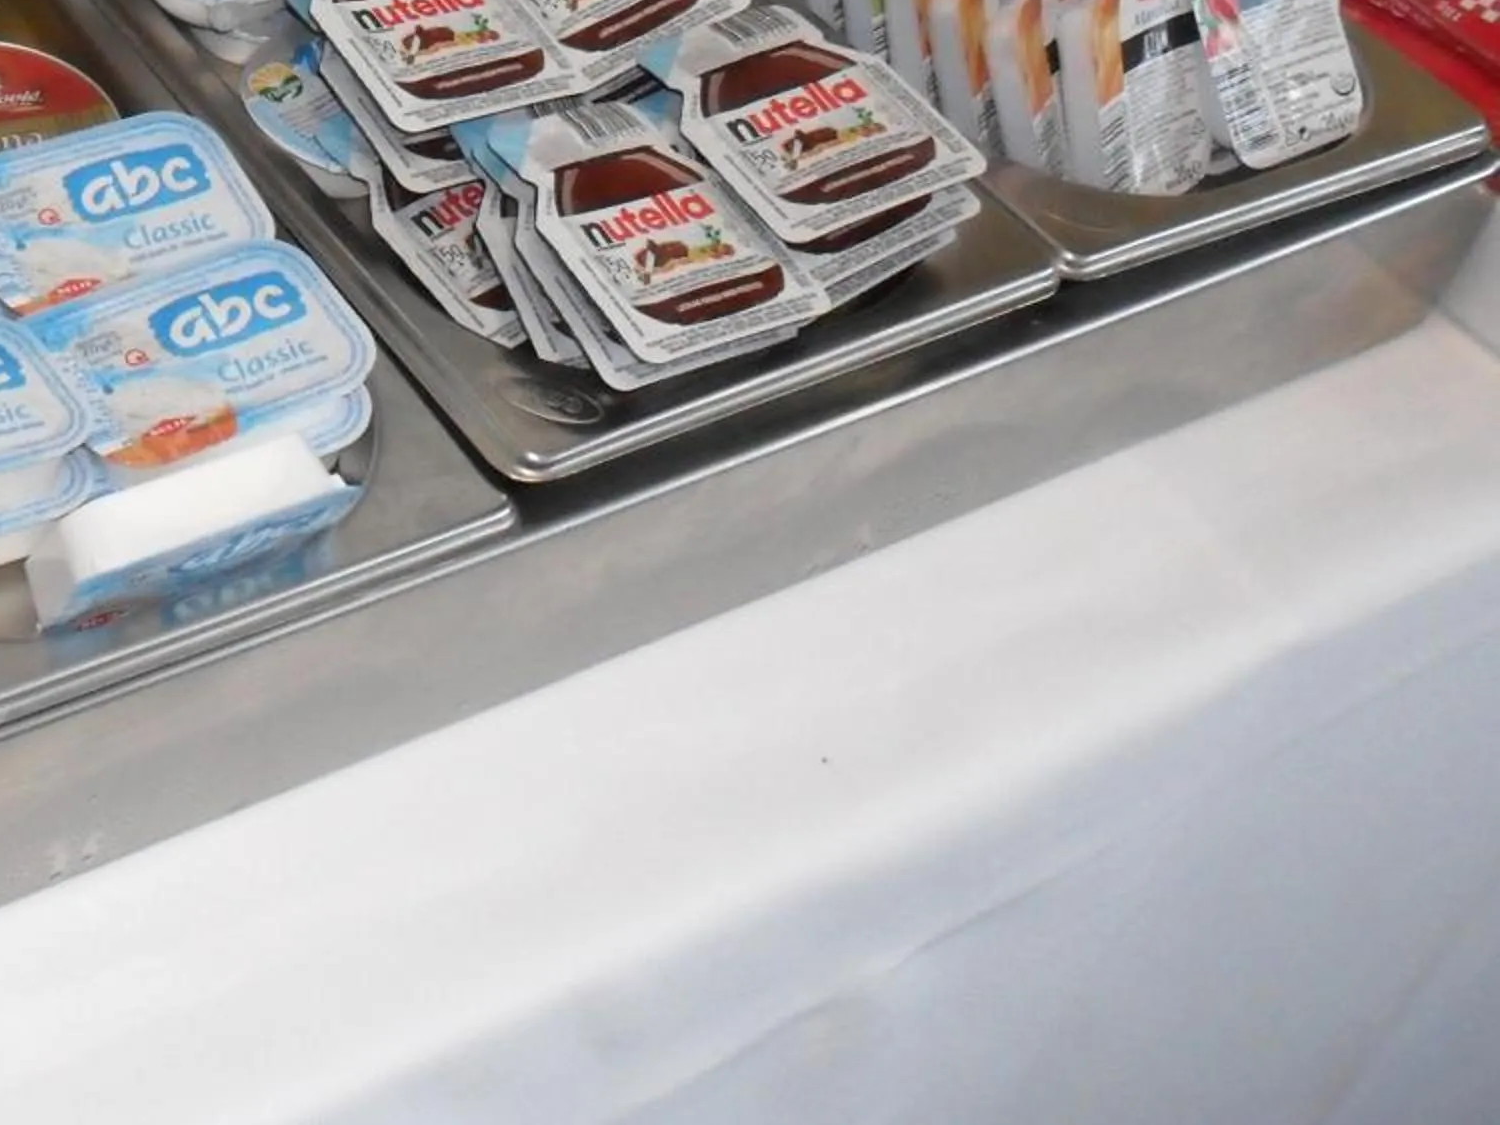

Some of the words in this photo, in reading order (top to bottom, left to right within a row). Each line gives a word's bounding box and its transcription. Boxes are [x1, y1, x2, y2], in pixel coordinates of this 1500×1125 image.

[726, 77, 868, 143] nutella
[80, 156, 198, 215] abc
[411, 184, 485, 238] nute
[123, 211, 218, 250] Classic
[580, 191, 715, 249] nutella
[169, 283, 292, 349] abc
[218, 338, 316, 384] Classic
